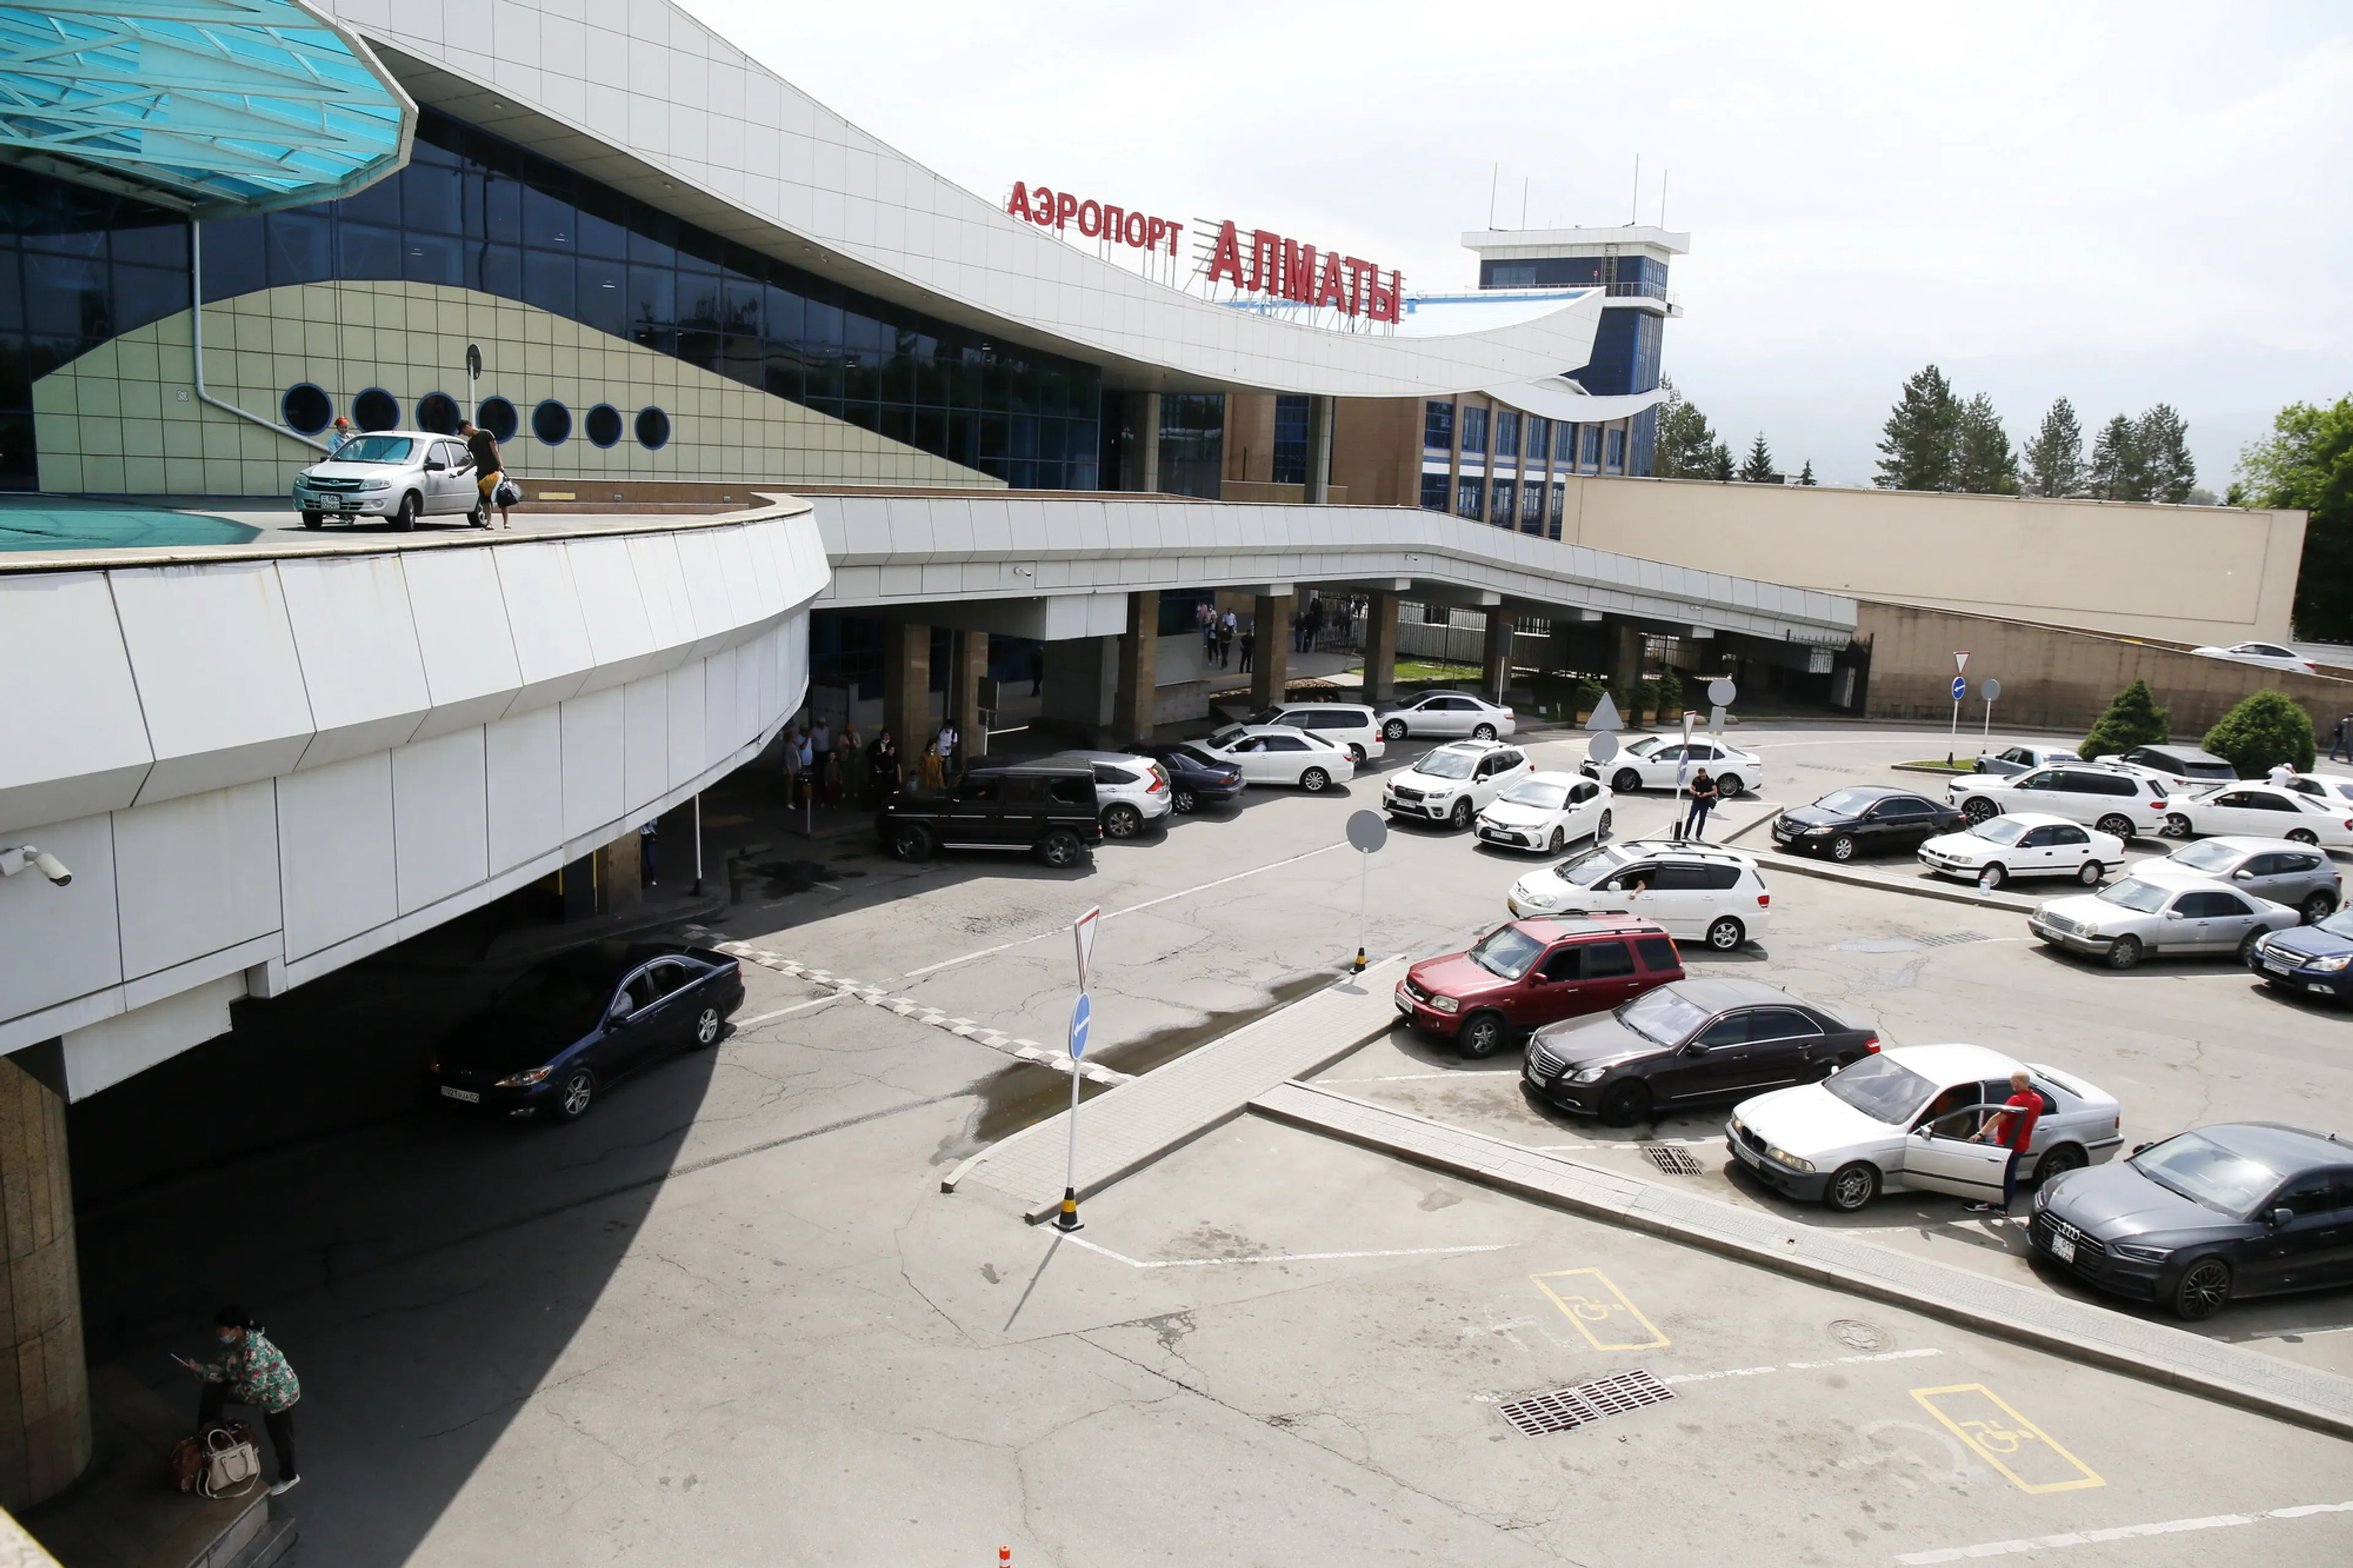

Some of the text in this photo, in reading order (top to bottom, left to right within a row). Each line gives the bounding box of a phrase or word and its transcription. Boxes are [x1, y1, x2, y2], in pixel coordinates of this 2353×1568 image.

[1008, 181, 1400, 324] АЭРОПОРТ АЛМАТЫ
[2061, 1240, 2074, 1252] 011
